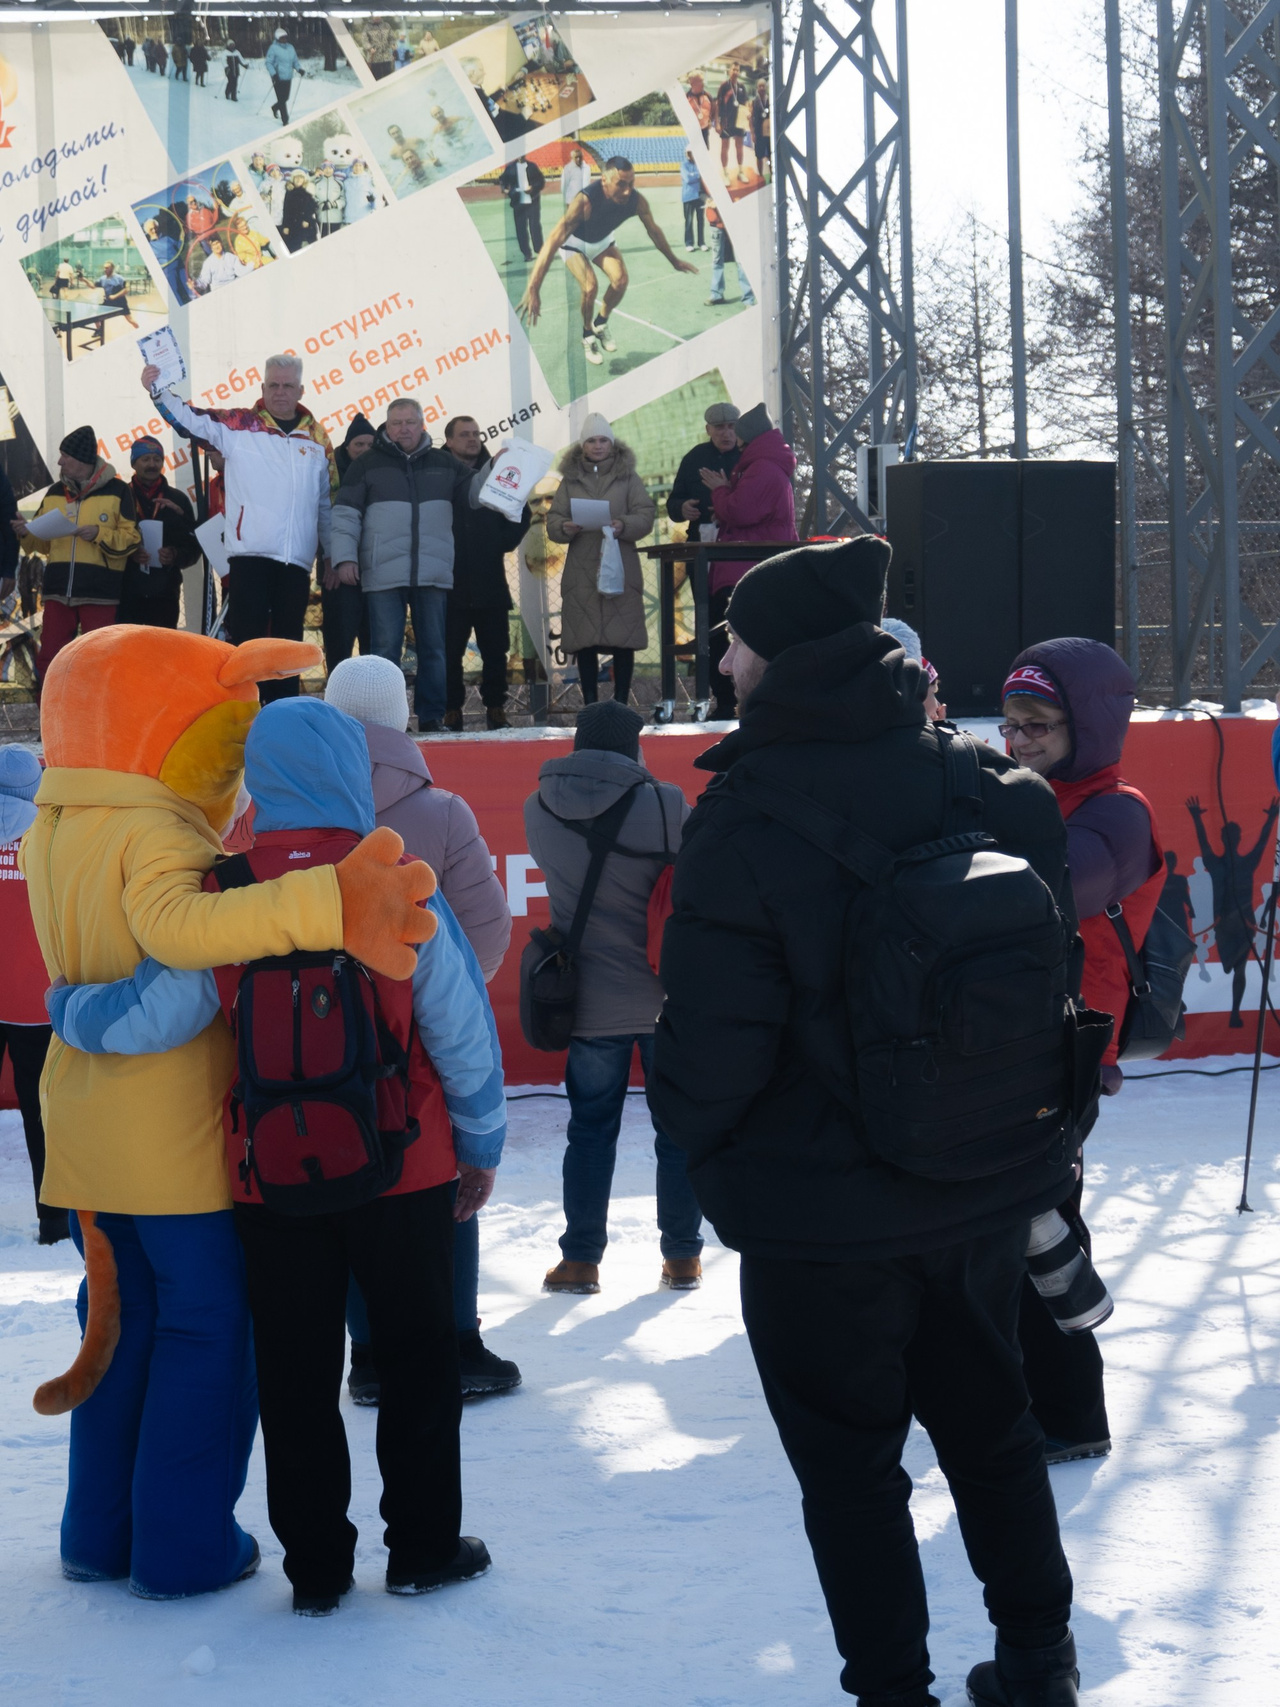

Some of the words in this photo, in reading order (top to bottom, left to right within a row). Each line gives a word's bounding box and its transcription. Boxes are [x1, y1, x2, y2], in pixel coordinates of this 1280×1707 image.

[16, 164, 109, 243] душой!
[200, 366, 263, 406] тебя
[304, 291, 415, 355] остудит,
[311, 367, 345, 395] не
[348, 327, 423, 375] беда;
[318, 366, 430, 434] старятся
[435, 327, 512, 376] люди,
[480, 402, 542, 444] овская
